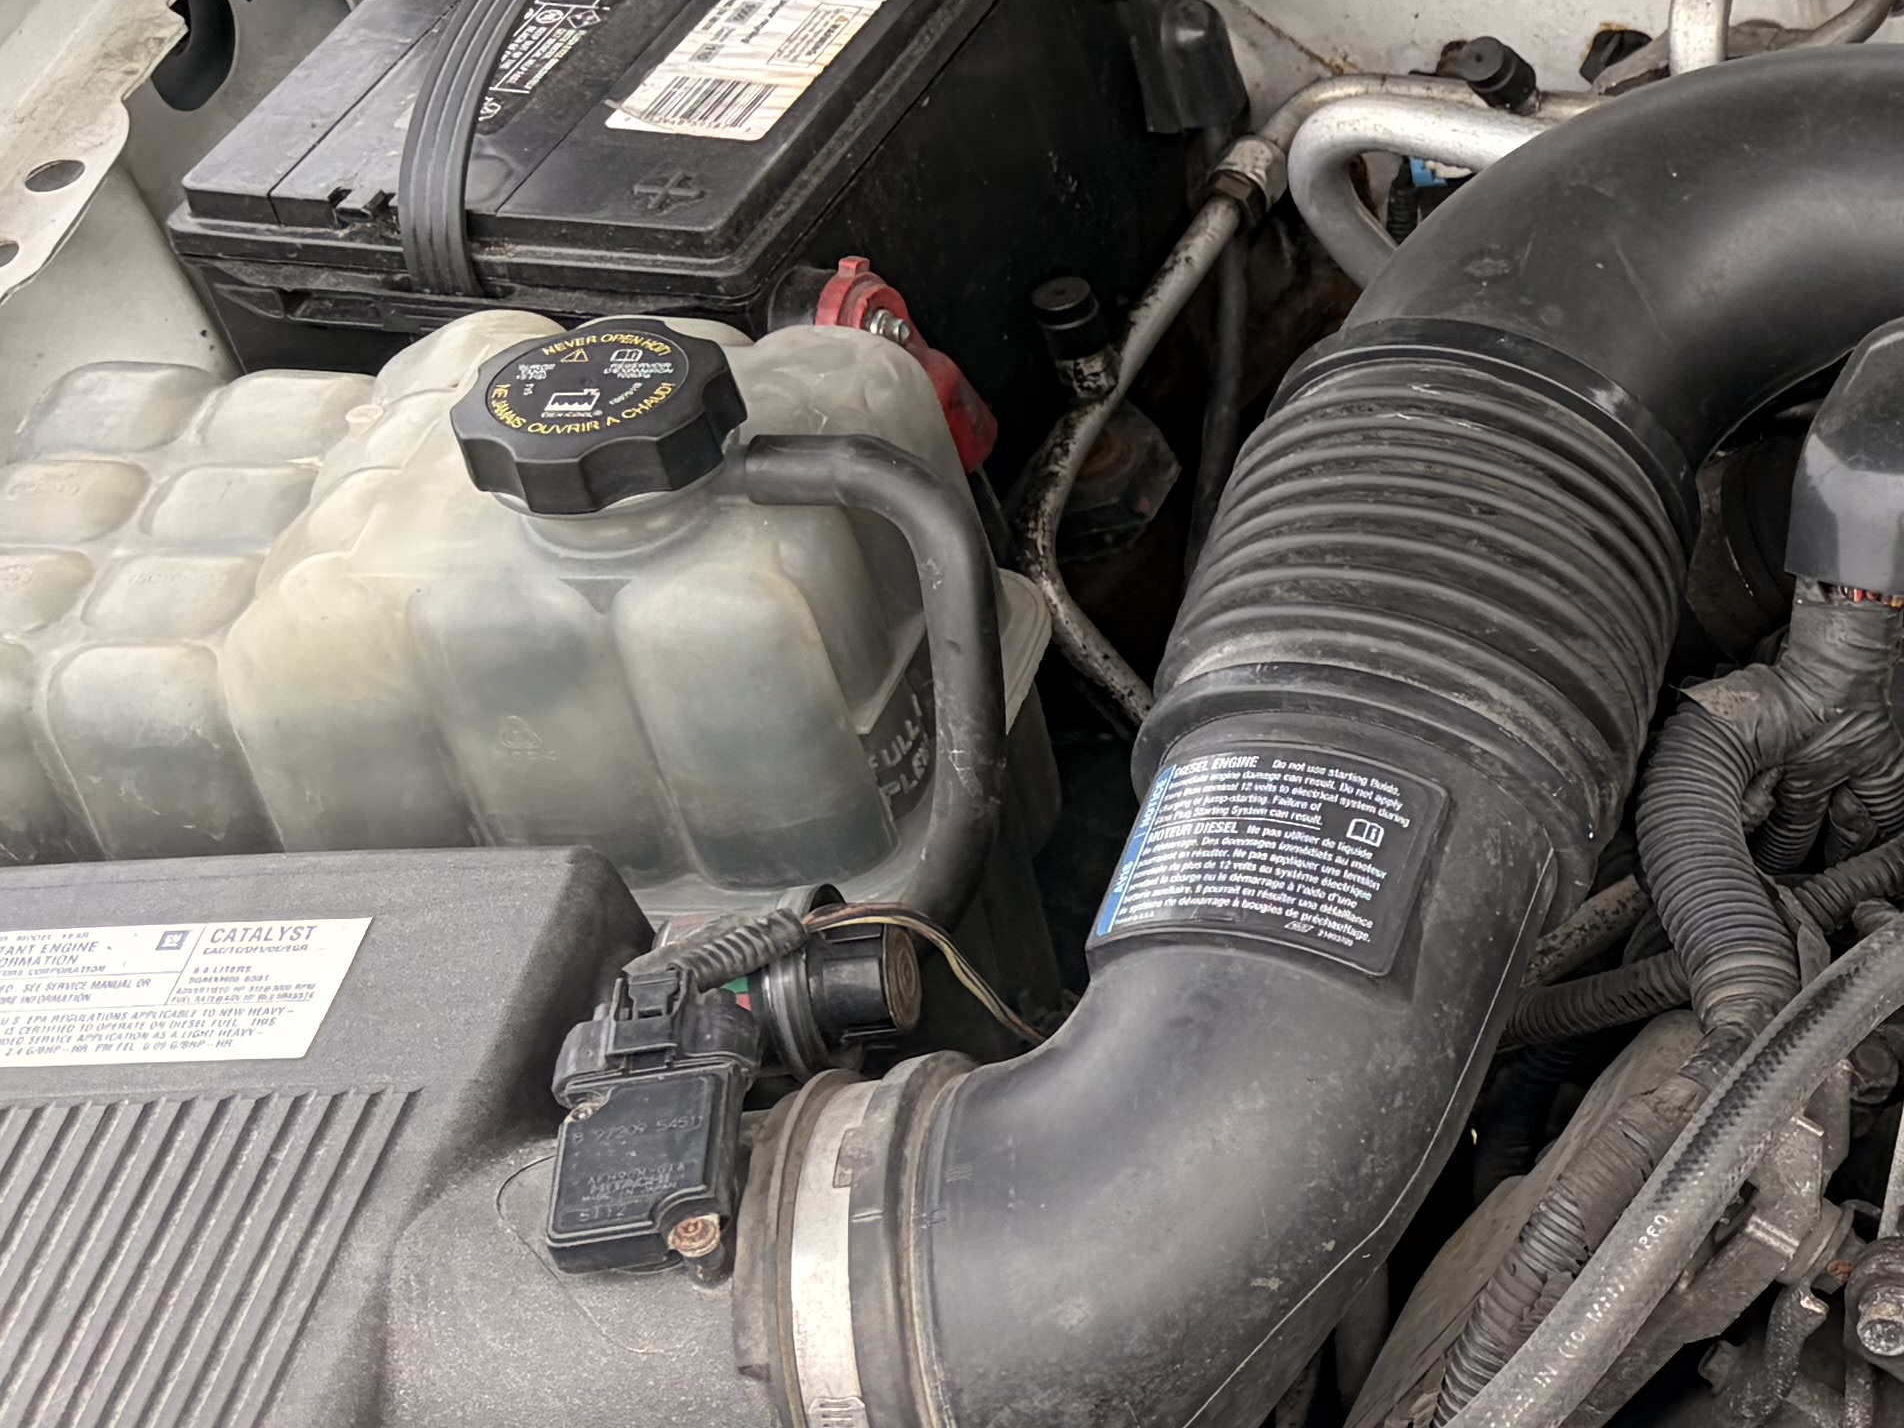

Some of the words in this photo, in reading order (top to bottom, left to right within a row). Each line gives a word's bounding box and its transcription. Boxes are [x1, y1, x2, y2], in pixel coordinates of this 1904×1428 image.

[542, 335, 598, 356] NEVER
[600, 333, 641, 347] OPEN
[527, 421, 600, 434] OUVRIR
[606, 416, 620, 427] A
[1211, 755, 1260, 770] ENGINE
[1272, 759, 1287, 769] Do
[1288, 762, 1305, 773] not
[1307, 765, 1327, 775] use
[1328, 767, 1368, 787] starting
[1242, 771, 1281, 782] damage
[1283, 774, 1302, 784] can
[1339, 783, 1354, 794] Do
[1355, 788, 1374, 801] not
[1374, 795, 1403, 811] apply
[1241, 782, 1252, 791] 12
[1254, 784, 1277, 793] volts
[1279, 784, 1289, 794] to
[1291, 787, 1339, 804] electrical
[1339, 796, 1376, 815] system
[1377, 807, 1410, 829] during
[1272, 794, 1307, 810] Failure
[1309, 800, 1323, 812] of
[1193, 806, 1230, 817] Starting
[1231, 805, 1267, 815] System
[1269, 808, 1289, 819] can
[1290, 811, 1323, 825] result.
[1147, 824, 1192, 844] MOTEUR
[1194, 822, 1238, 835] DIESEL
[1247, 824, 1262, 834] Ne
[1262, 827, 1282, 838] pas
[1321, 838, 1336, 849] de
[1337, 841, 1373, 860] liquide
[1221, 836, 1277, 850] dommages
[1335, 854, 1349, 867] au
[1350, 859, 1387, 880] moteur
[1232, 848, 1248, 857] Ne
[1248, 851, 1268, 861] pas
[1269, 851, 1320, 871] appliquer
[1321, 863, 1341, 877] une
[1343, 868, 1380, 891] tension
[1218, 861, 1231, 870] 12
[1233, 862, 1257, 872] volts
[1274, 865, 1320, 884] système
[1321, 874, 1373, 900] électrique
[1229, 873, 1286, 889] démarrage
[1286, 880, 1295, 891] à
[1327, 891, 1358, 910] d'une
[1241, 898, 1283, 916] bougies
[1284, 907, 1300, 920] de
[1298, 898, 1318, 911] une
[210, 925, 318, 945] CATALYST
[40, 940, 100, 954] ENGINE
[45, 980, 88, 992] SERVICE
[90, 979, 133, 990] MANUAL
[136, 978, 152, 988] OR
[27, 1015, 48, 1025] EPA
[51, 1011, 129, 1024] REGULATIONS
[131, 1008, 197, 1020] APPLICABLE
[203, 1008, 216, 1018] TO
[219, 1007, 246, 1018] NEW
[4, 1026, 15, 1035] IS
[18, 1023, 76, 1035] CERTIFIED
[79, 1023, 93, 1033] TO
[95, 1021, 146, 1032] OPERATE
[149, 1020, 166, 1031] ON
[169, 1019, 206, 1030] DIESEL
[28, 1035, 73, 1046] SERVICE
[77, 1031, 149, 1043] APPLICATION
[152, 1030, 167, 1040] AS
[181, 1029, 216, 1039] LIGHT
